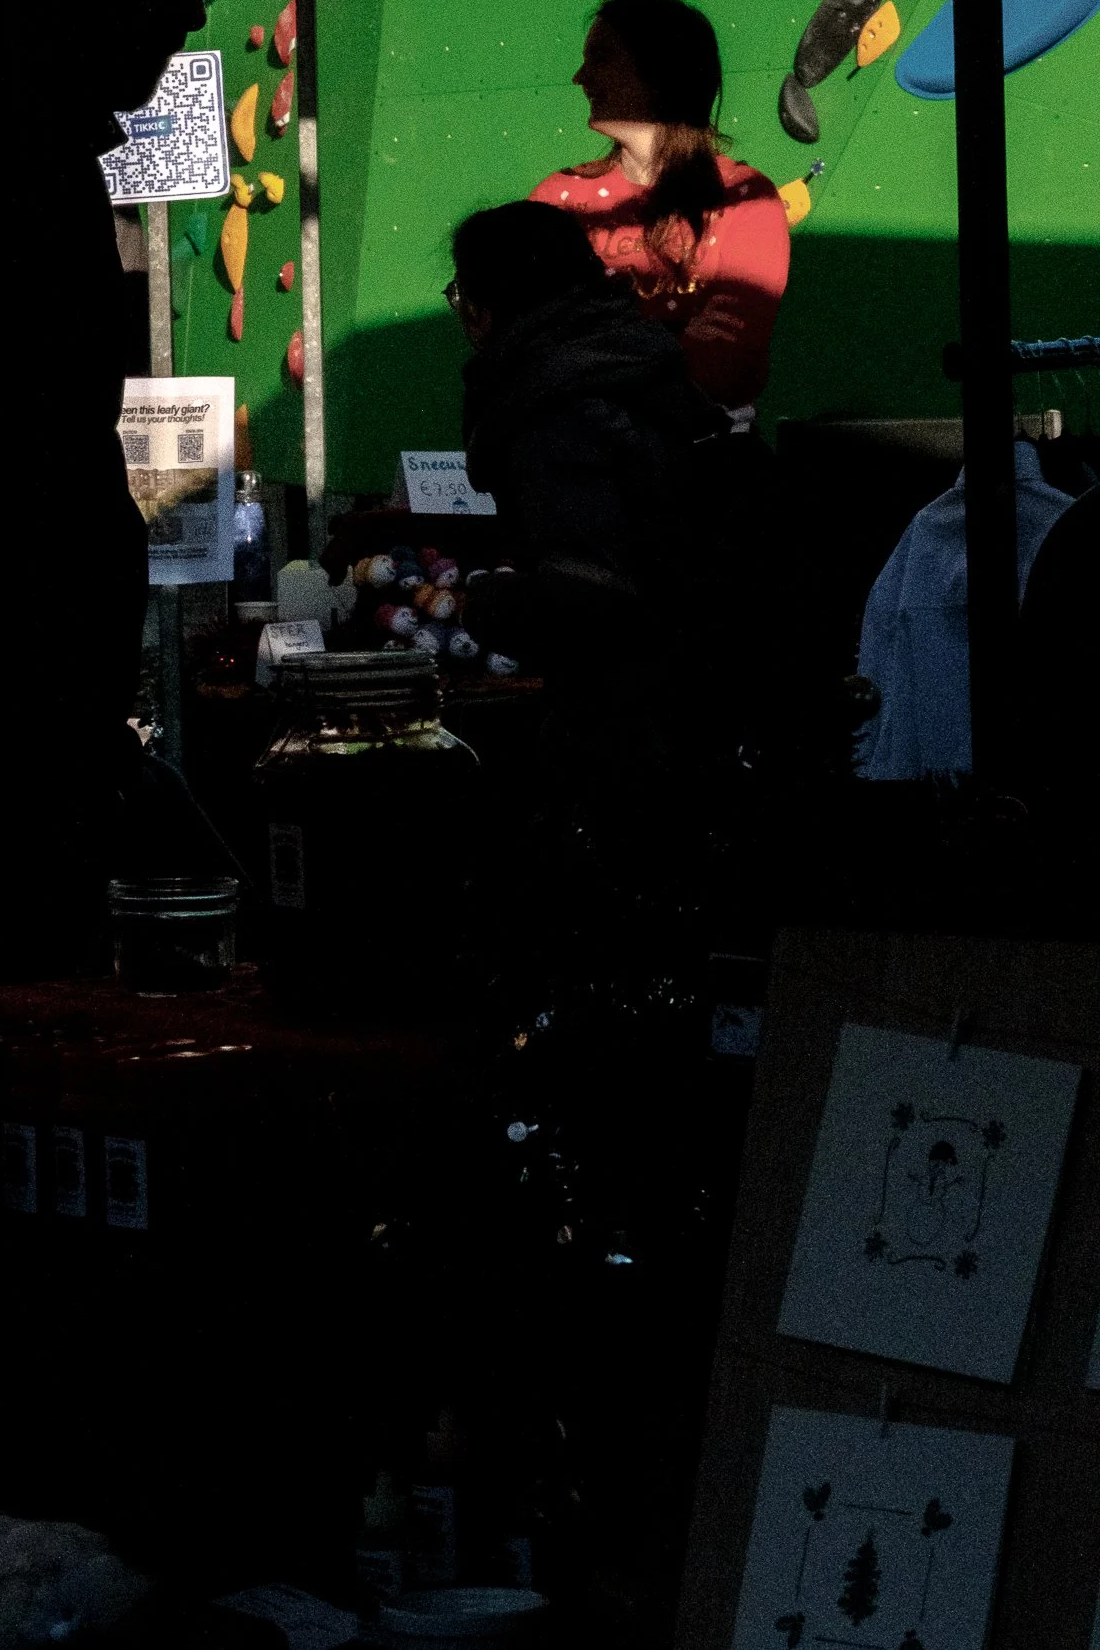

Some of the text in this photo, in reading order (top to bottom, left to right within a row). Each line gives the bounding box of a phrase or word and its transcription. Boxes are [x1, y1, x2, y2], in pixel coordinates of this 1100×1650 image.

[122, 403, 211, 416] een this leafy giant?
[146, 415, 166, 425] your
[167, 413, 206, 424] thoughts!
